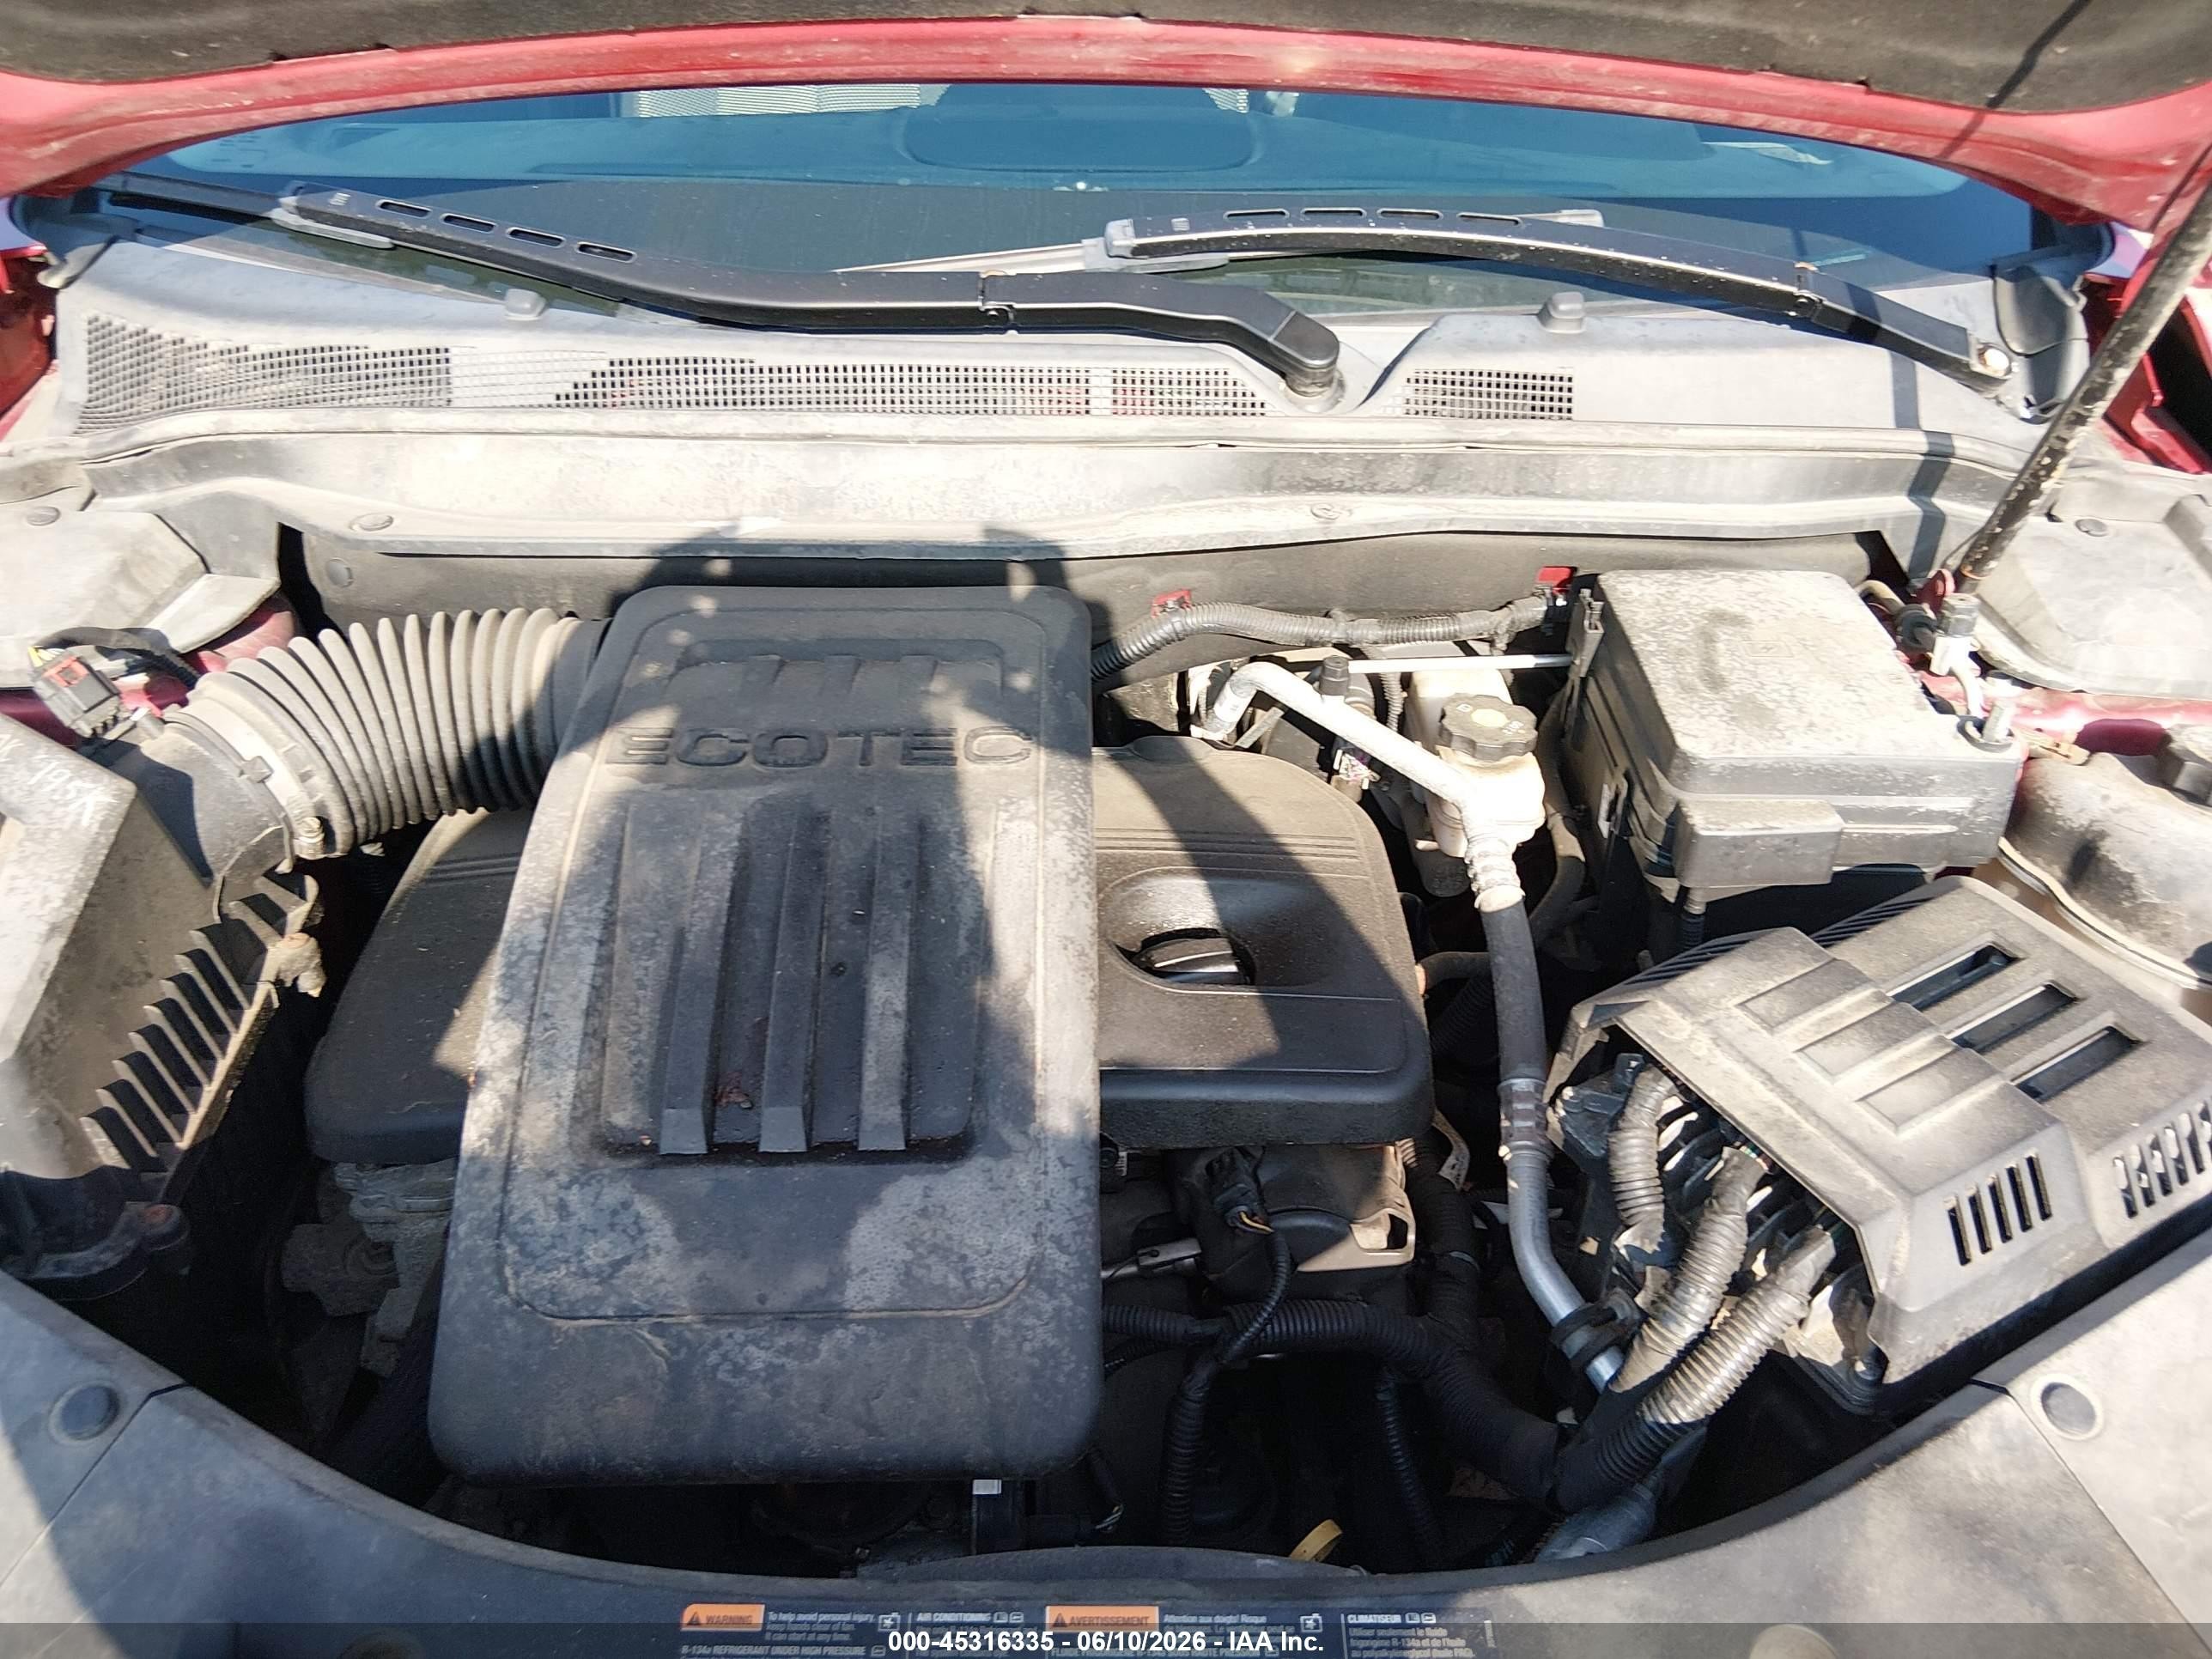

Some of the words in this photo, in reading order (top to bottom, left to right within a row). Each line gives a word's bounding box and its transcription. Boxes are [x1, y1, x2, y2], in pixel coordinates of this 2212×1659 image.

[604, 725, 1033, 768] ECOTEC
[705, 1614, 753, 1625] WARNING
[933, 1613, 992, 1622] CONDITIONING
[1070, 1615, 1149, 1626] AVERTISSEMENT
[1346, 1614, 1402, 1624] CLIMATISEUR
[712, 1645, 770, 1655] REFRIGERANT
[823, 1646, 866, 1656] PRESSURE
